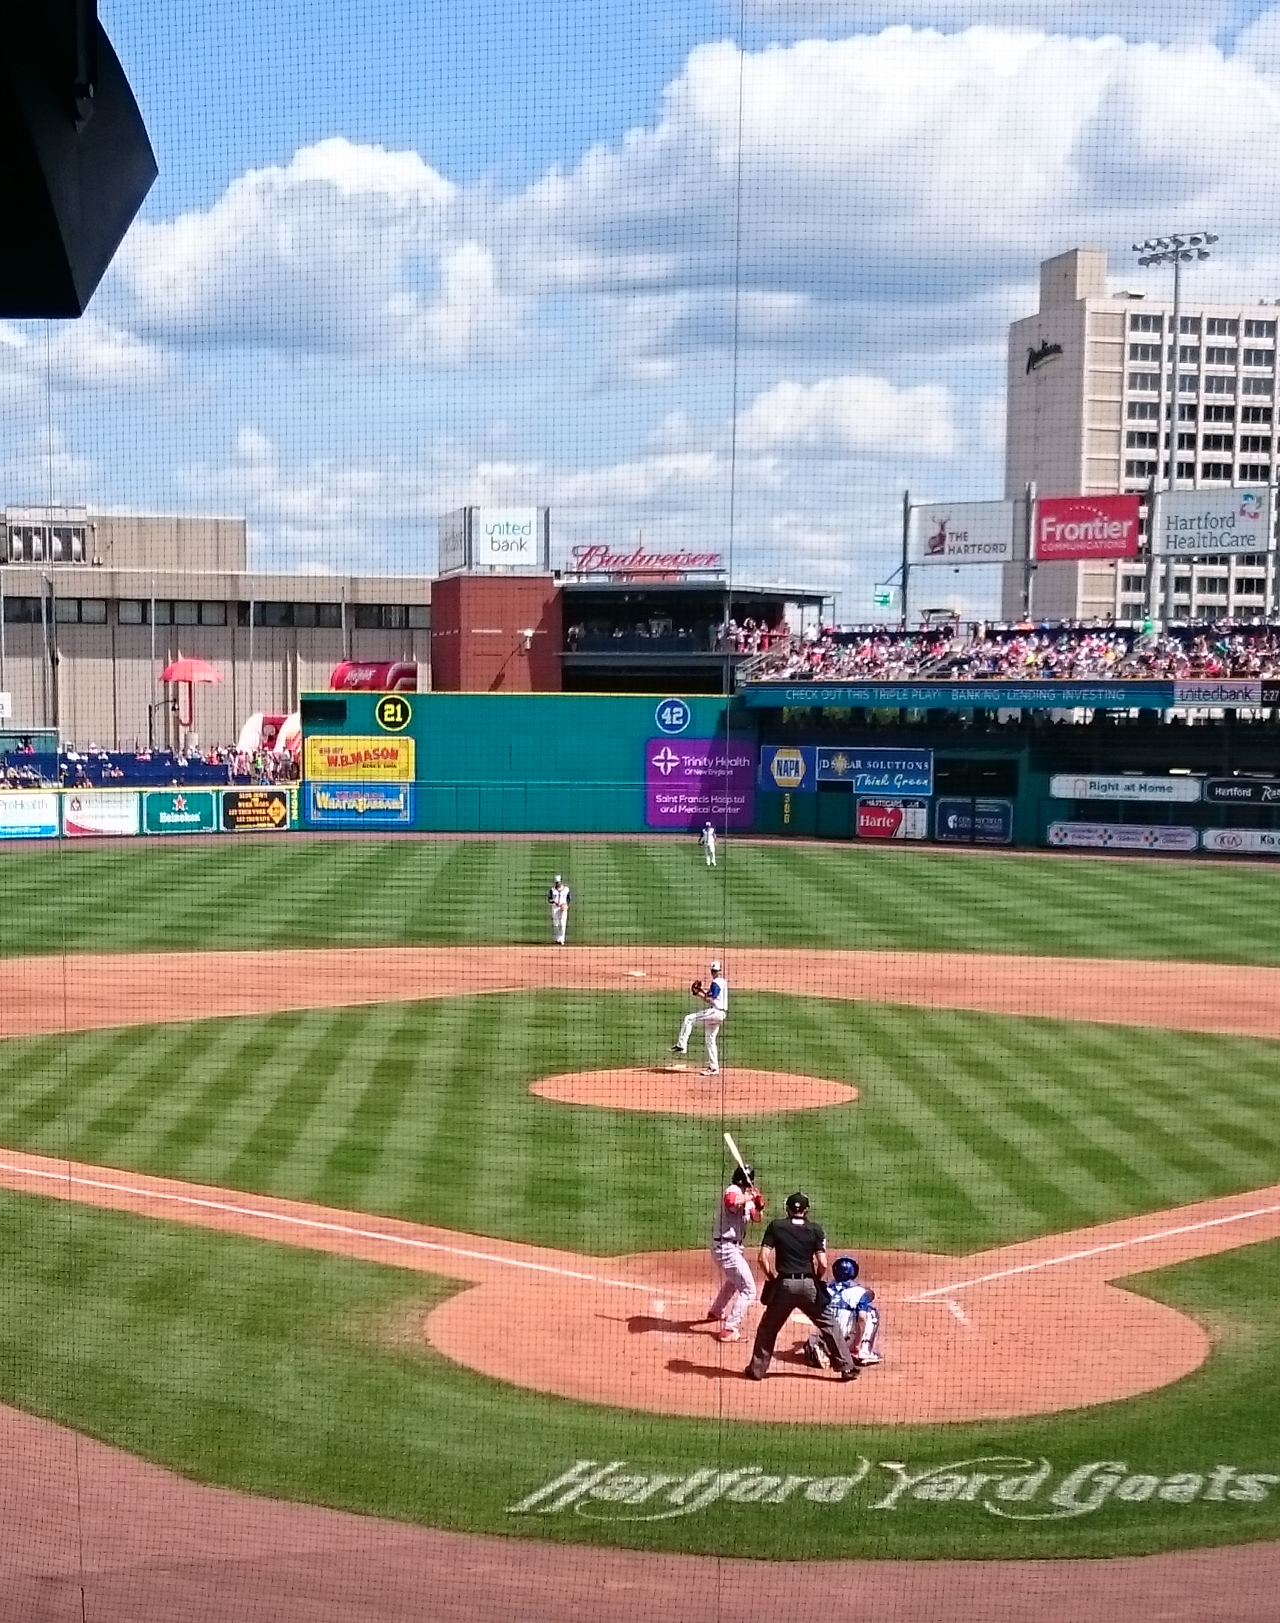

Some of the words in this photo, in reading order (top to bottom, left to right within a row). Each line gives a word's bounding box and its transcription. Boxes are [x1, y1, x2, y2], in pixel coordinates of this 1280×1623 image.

[485, 519, 532, 536] united
[1166, 510, 1236, 531] Hartford
[948, 531, 968, 542] THE
[1040, 517, 1133, 542] Frontier
[490, 536, 529, 552] bank
[1040, 540, 1128, 552] COMMUNICATIONS
[1165, 531, 1257, 550] HealthCare
[947, 543, 1008, 555] HARTFORD
[571, 544, 722, 571] Budweiser
[785, 689, 818, 700] CHECK
[821, 689, 843, 700] OUT
[846, 689, 870, 700] THIS
[874, 689, 909, 700] TRIPLE
[912, 689, 941, 700] PLAY!
[951, 689, 1001, 701] BANKING
[1006, 689, 1057, 701] LENDING
[1062, 688, 1126, 701] INVESTING
[383, 703, 403, 722] 21
[661, 707, 684, 725] 42
[681, 755, 715, 769] Trinity
[716, 755, 750, 768] Health
[776, 759, 801, 777] NAPA
[866, 761, 930, 771] SOLUTIONS
[855, 773, 890, 786] Think
[893, 773, 930, 789] Green
[1088, 781, 1119, 793] Right
[1123, 783, 1136, 792] at
[1138, 783, 1174, 793] Home
[655, 794, 678, 803] Saint
[679, 795, 709, 804] Francis
[1214, 787, 1252, 797] Hartford
[660, 805, 677, 813] and
[678, 805, 711, 814] Medical
[711, 805, 741, 814] Center
[159, 812, 201, 823] Heineken
[859, 814, 895, 828] Harte
[1220, 835, 1238, 845] KIA
[1259, 834, 1275, 845] Kia
[506, 1454, 872, 1522] Hartford
[866, 1455, 1053, 1511] Yard
